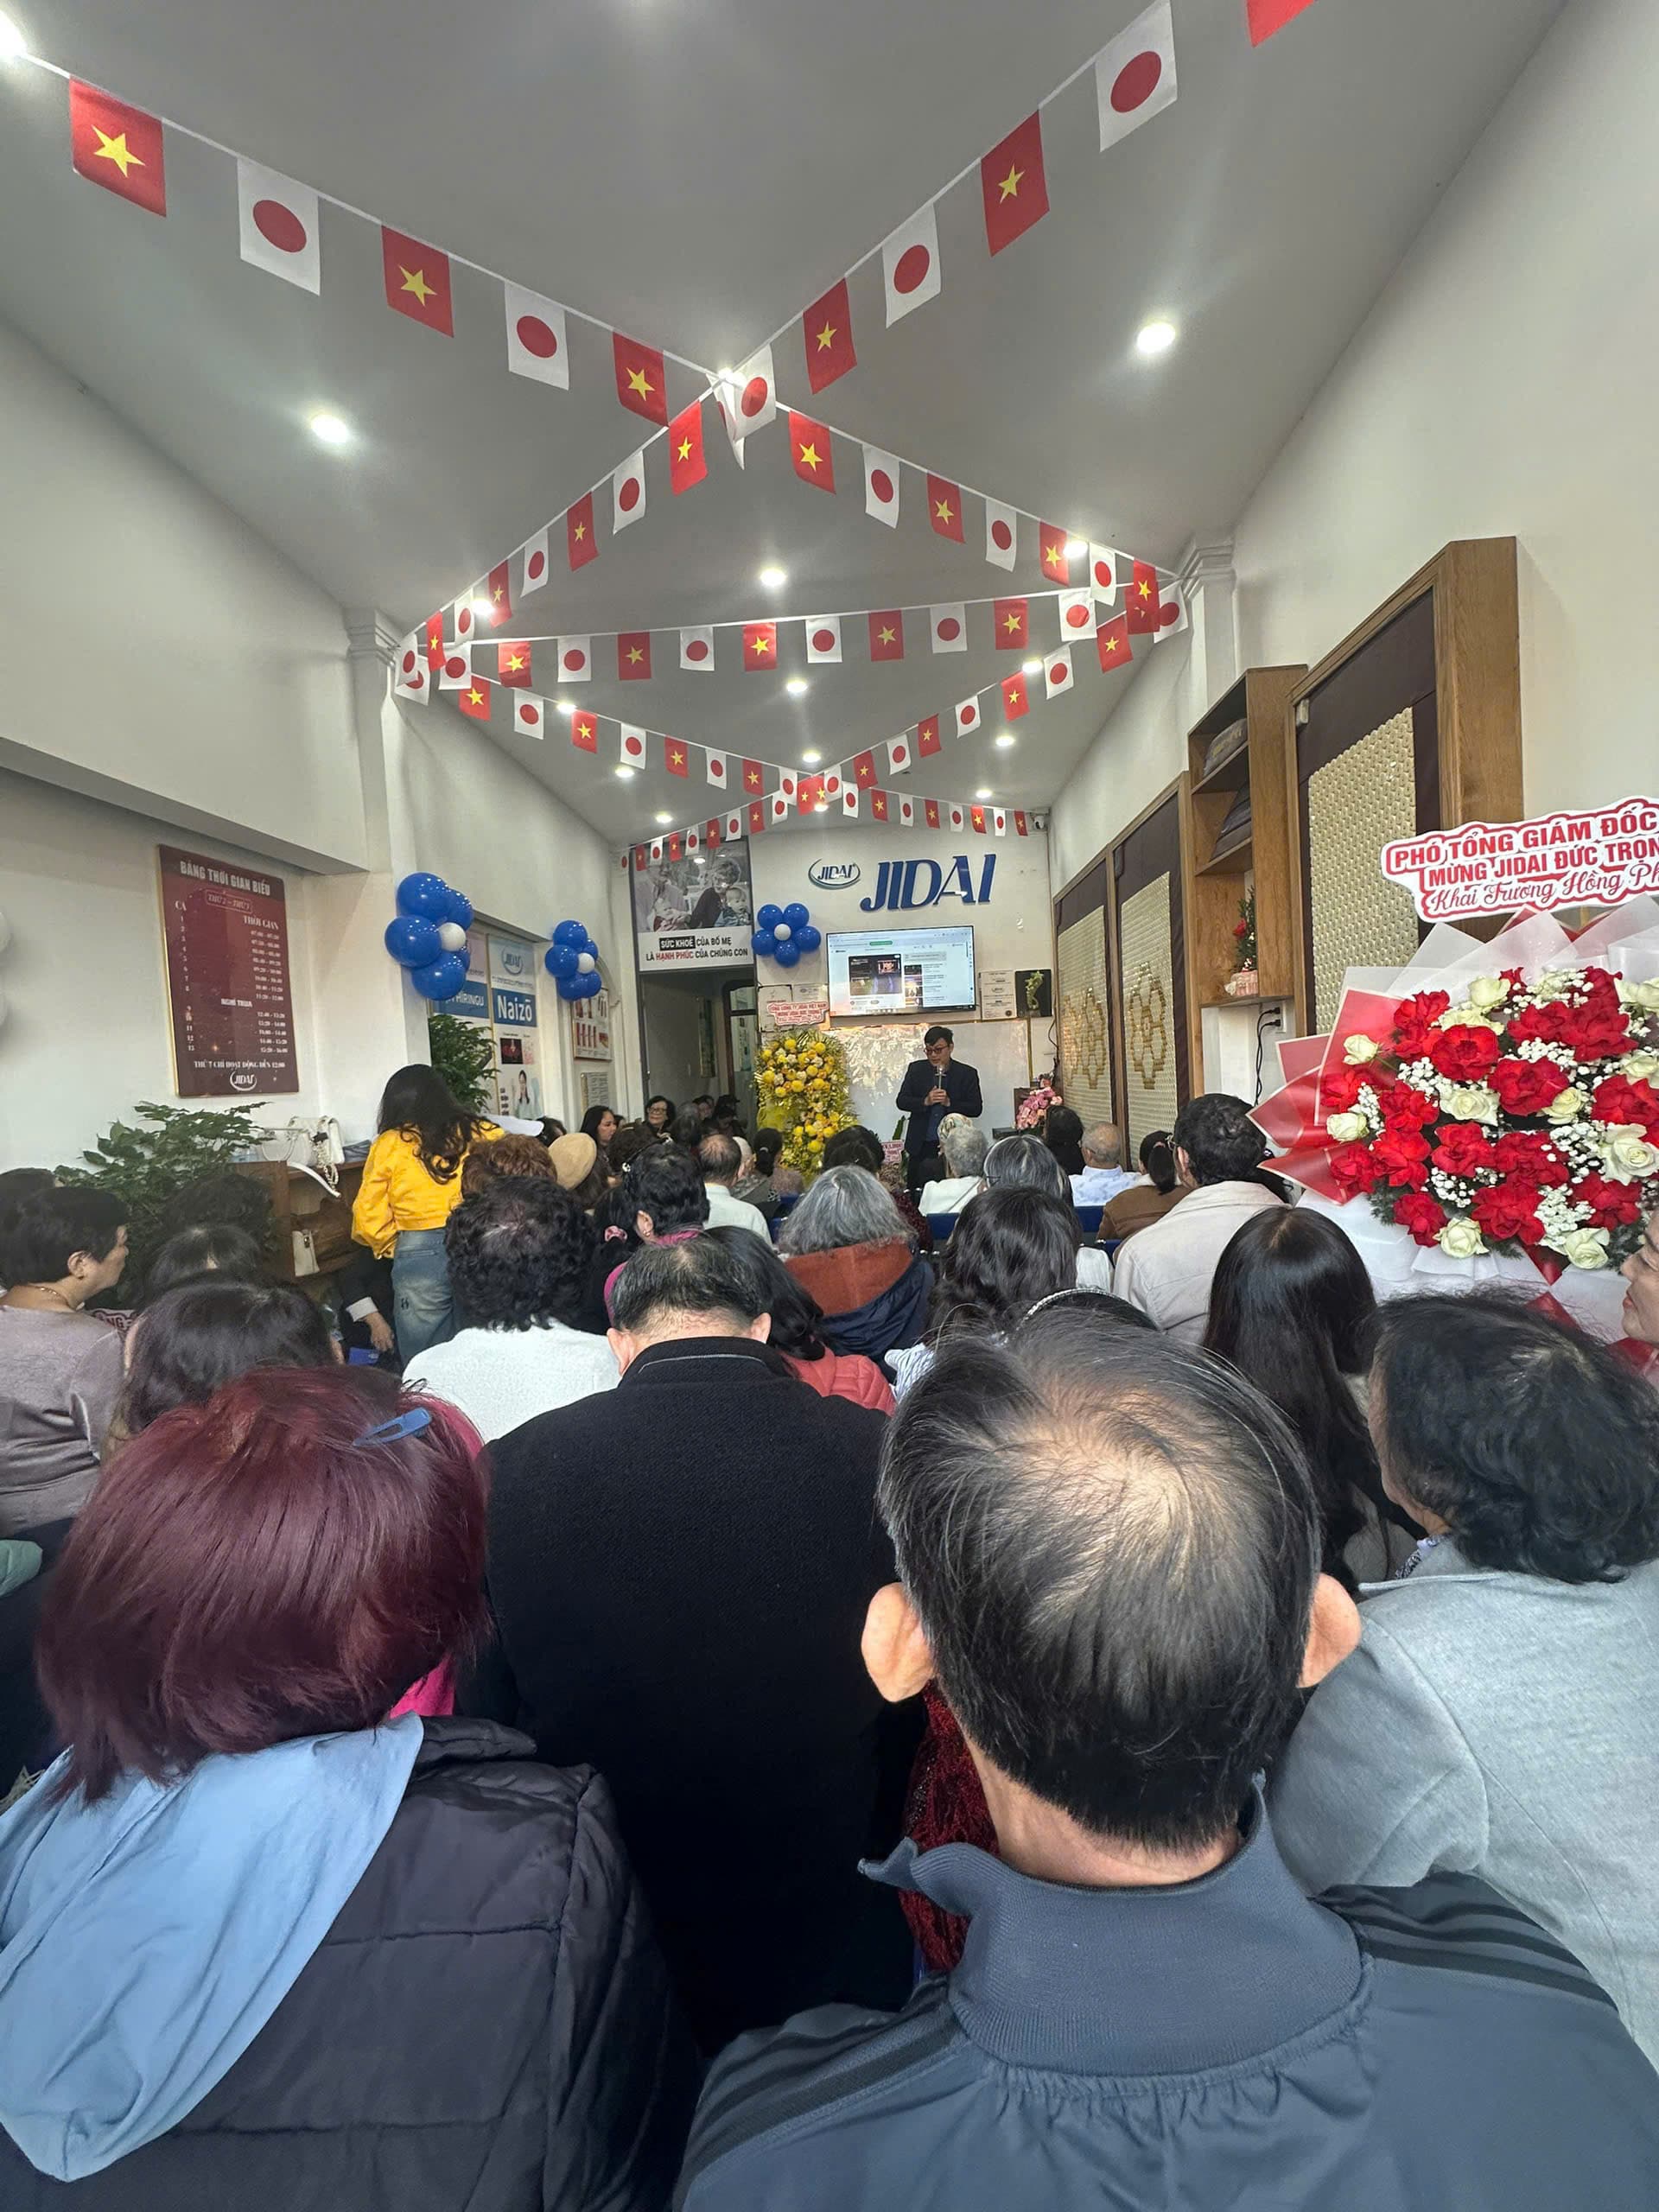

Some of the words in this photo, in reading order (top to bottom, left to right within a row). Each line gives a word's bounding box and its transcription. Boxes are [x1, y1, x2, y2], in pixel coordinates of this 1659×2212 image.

[1395, 841, 1441, 868] PHÓ
[1448, 831, 1514, 860] TỔNG
[1522, 821, 1592, 849] GIÁM
[1600, 806, 1657, 836] ĐỐC
[180, 861, 206, 880] BẢNG
[230, 874, 251, 891] GIAN
[817, 864, 853, 880] JIDAI
[1428, 862, 1488, 887] MỪNG
[1494, 853, 1548, 878] JIDAI
[1554, 844, 1599, 869] ĐỨC
[860, 854, 997, 912] JIDAI
[1430, 887, 1478, 912] Khai
[1484, 880, 1554, 905] Trương
[1562, 869, 1624, 898] Hồng
[645, 951, 655, 961] LÀ
[656, 952, 675, 962] HẠNH
[676, 950, 694, 960] PHÚC
[695, 949, 710, 958] CỦA
[710, 948, 733, 957] CHÚNG
[734, 948, 748, 957] CON
[660, 938, 675, 949] SỨC
[696, 936, 710, 946] CỦA
[711, 935, 721, 945] BỐ
[721, 937, 732, 946] MẸ
[497, 995, 533, 1021] Naizō
